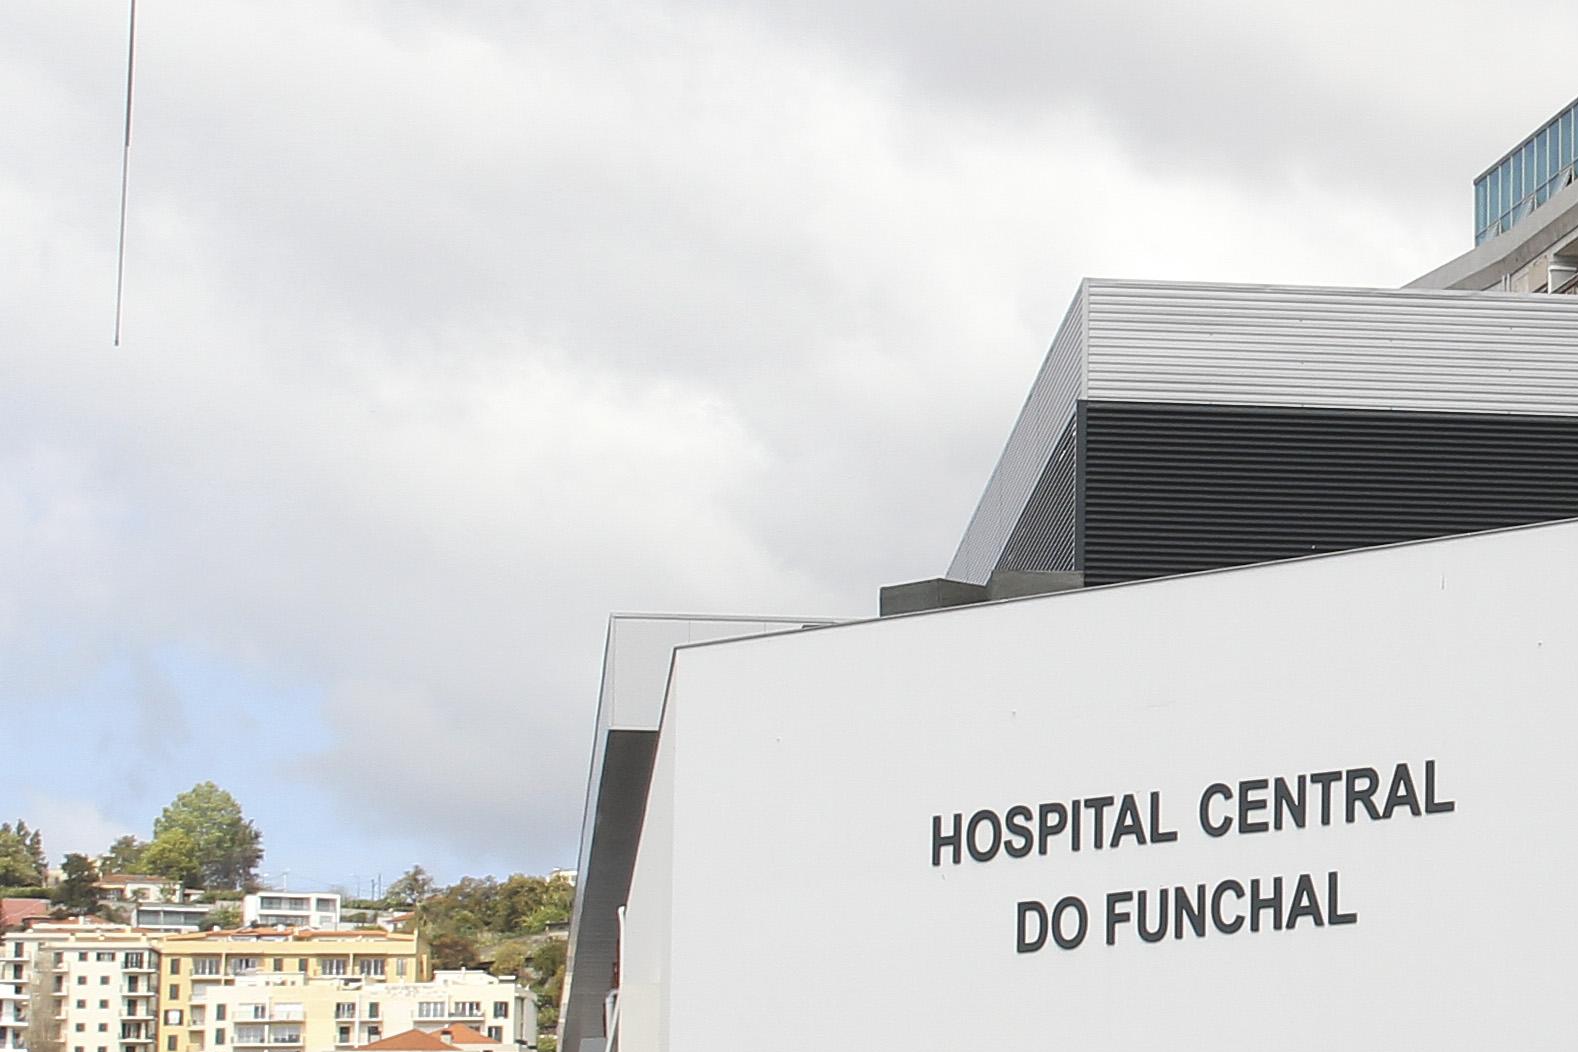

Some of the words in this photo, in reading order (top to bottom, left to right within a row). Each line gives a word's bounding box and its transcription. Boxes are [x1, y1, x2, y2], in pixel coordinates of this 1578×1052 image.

[932, 790, 1178, 866] HOSPITAL
[1200, 759, 1455, 838] CENTRAL
[1016, 896, 1088, 953] DO
[1105, 871, 1358, 945] FUNCHAL
